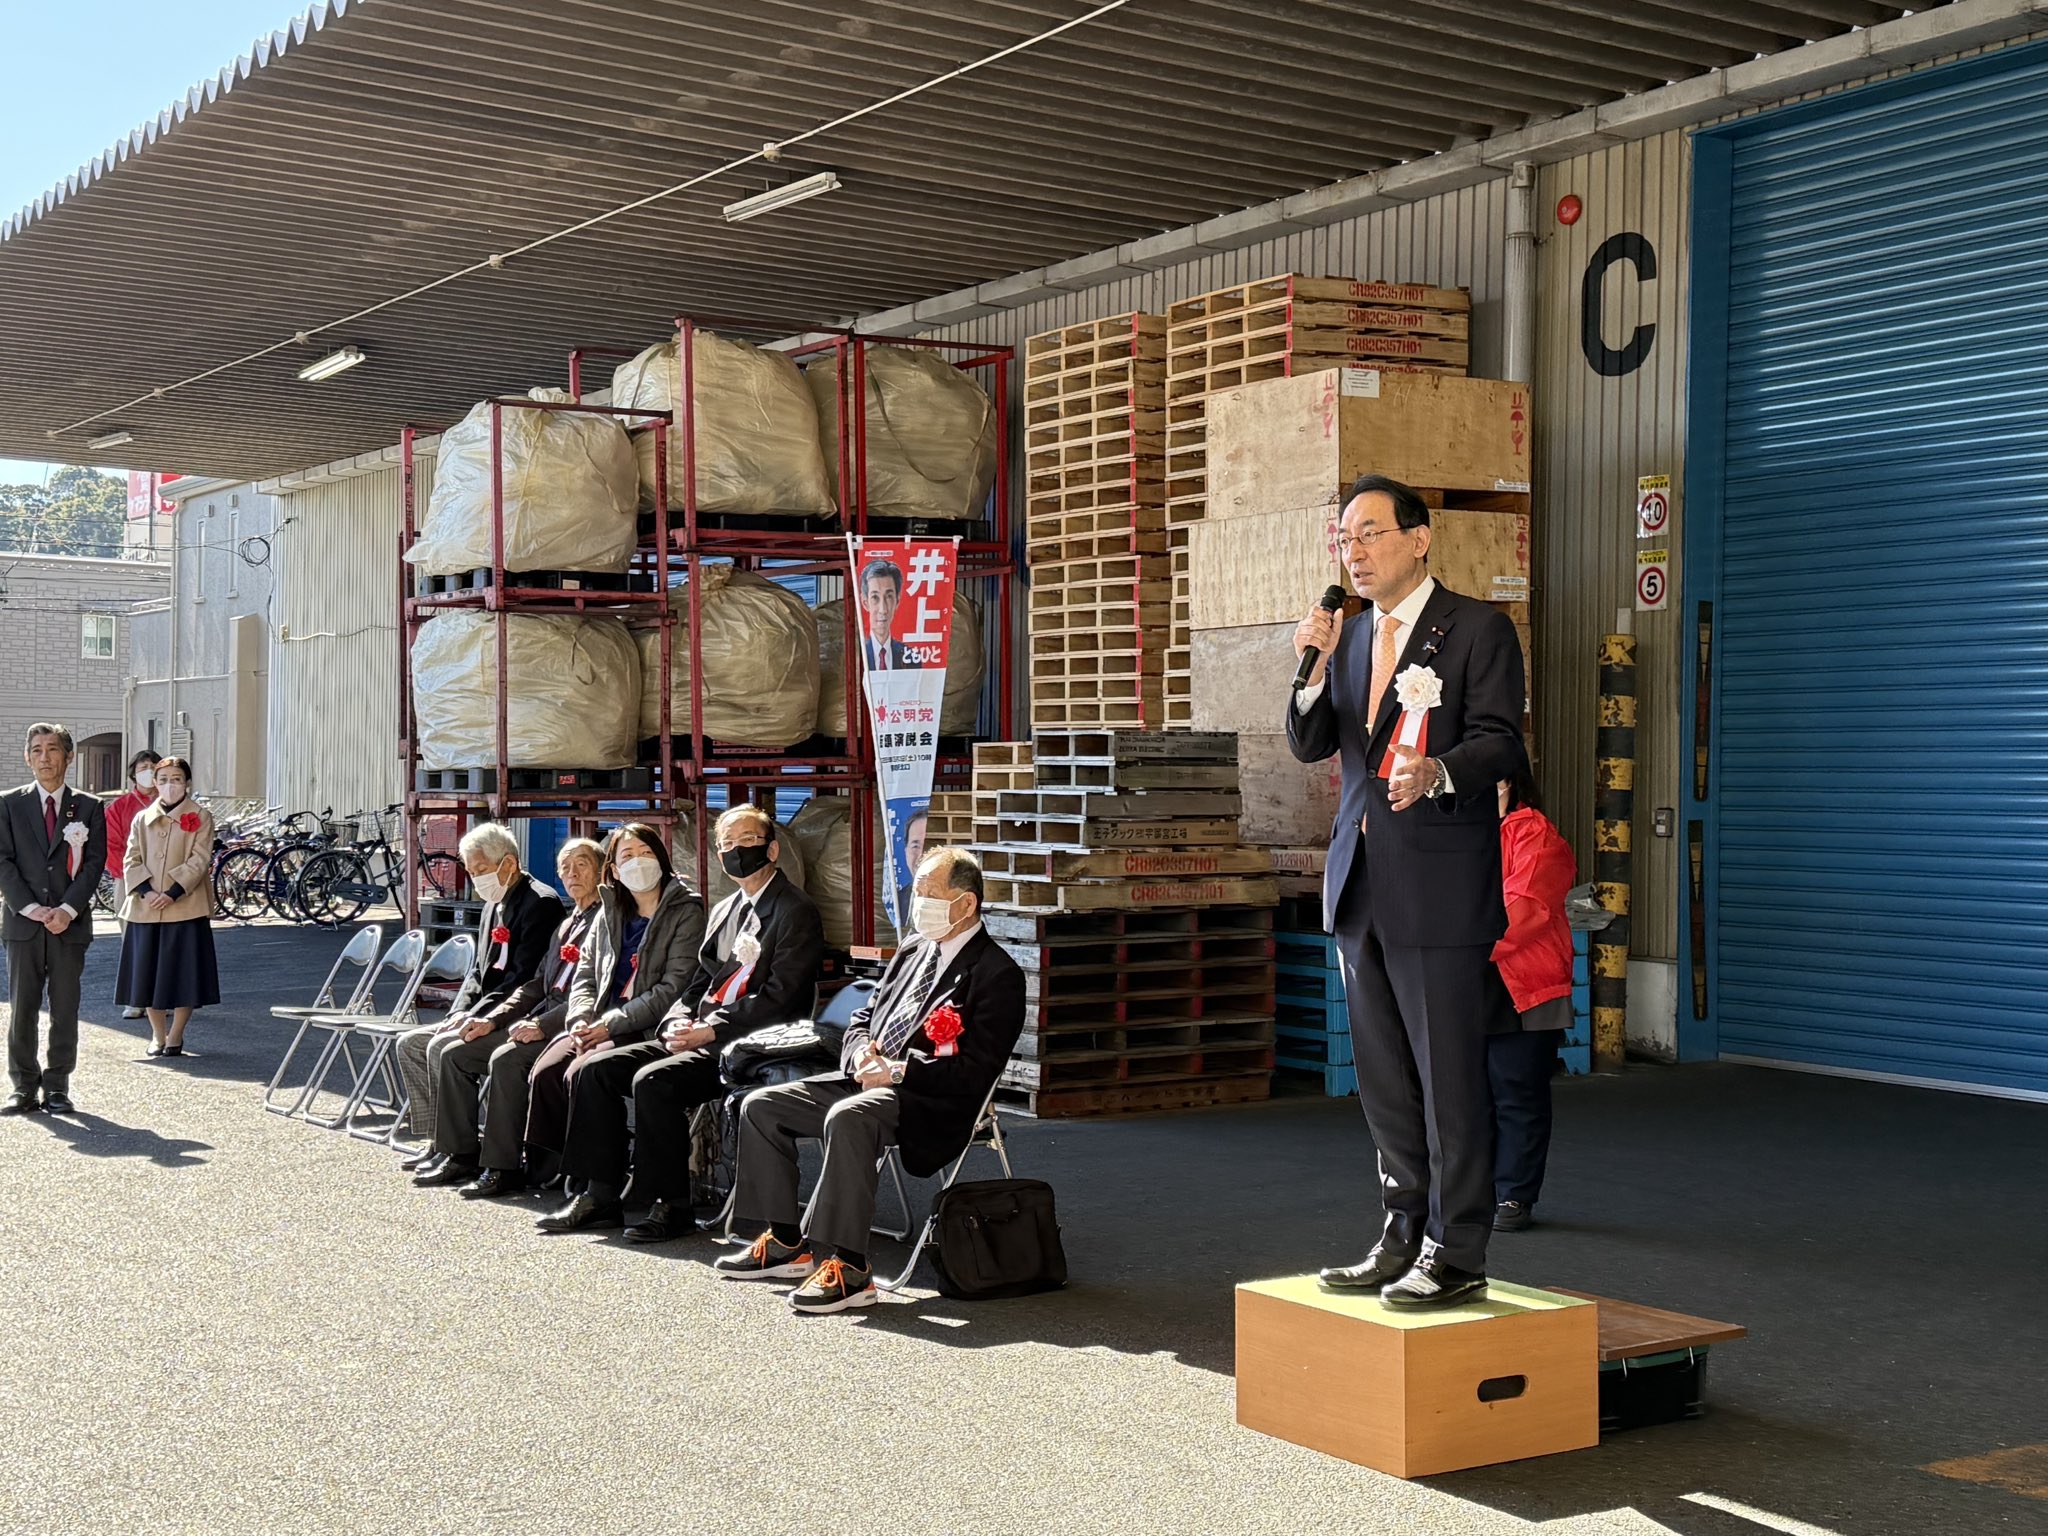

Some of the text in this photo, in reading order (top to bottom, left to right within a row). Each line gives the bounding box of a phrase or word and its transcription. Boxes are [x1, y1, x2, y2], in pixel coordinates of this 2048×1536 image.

[1582, 232, 1657, 377] C
[1646, 501, 1662, 521] 10
[902, 548, 945, 642] 井上
[1646, 575, 1658, 597] 5
[902, 645, 941, 664] ともひと
[890, 707, 934, 723] 公明党
